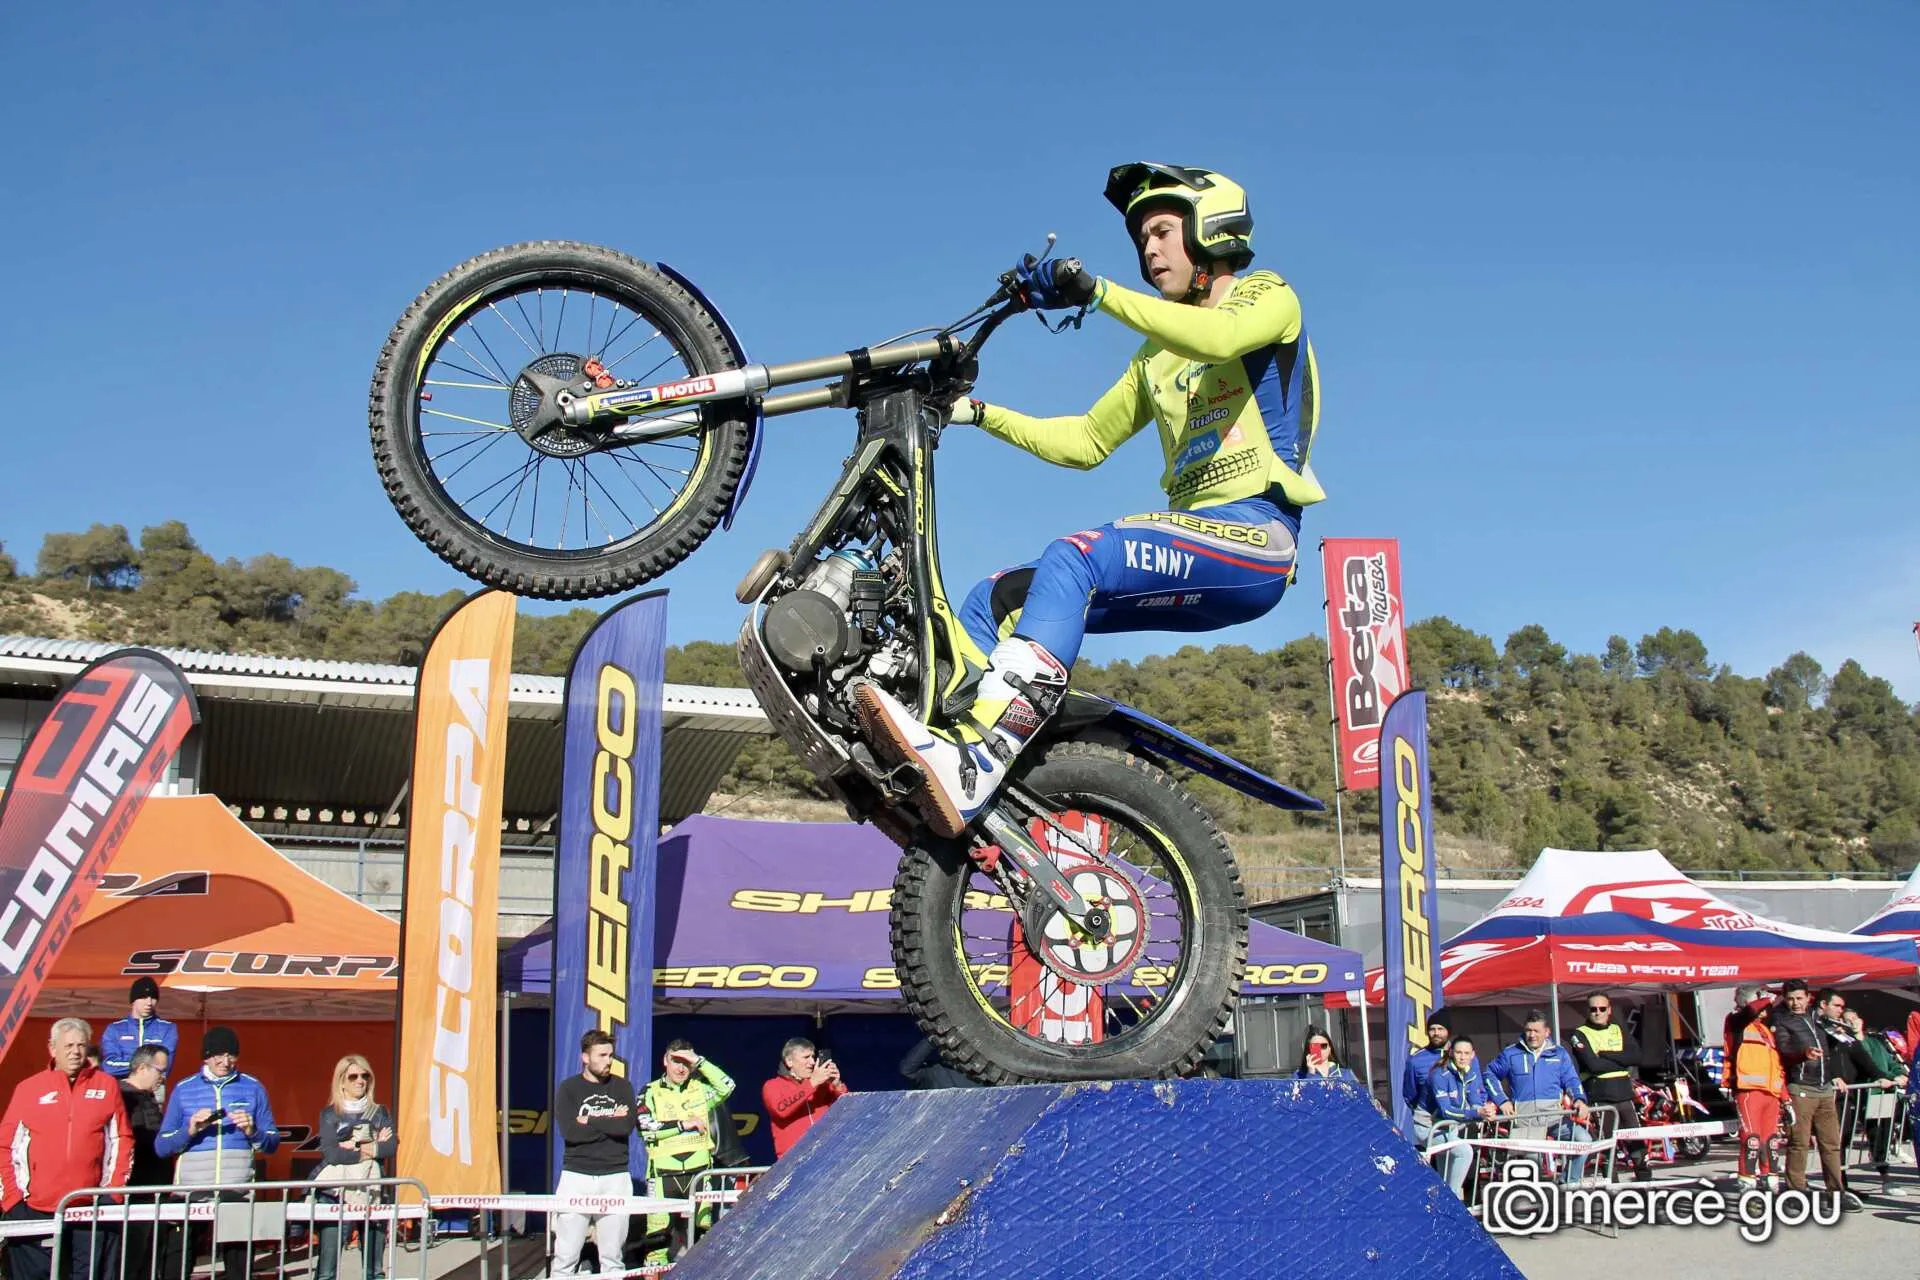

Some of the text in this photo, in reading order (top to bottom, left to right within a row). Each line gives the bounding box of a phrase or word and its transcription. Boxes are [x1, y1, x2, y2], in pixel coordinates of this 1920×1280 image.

[661, 378, 713, 399] MOTUL
[1189, 407, 1230, 430] TrialGo
[1123, 511, 1268, 547] SHERCO
[1124, 539, 1195, 580] KENNY
[1340, 557, 1384, 729] Beta
[429, 659, 490, 1166] SCORPA
[33, 895, 81, 980] FOR
[441, 1196, 501, 1209] octagon
[569, 1195, 625, 1212] octagon
